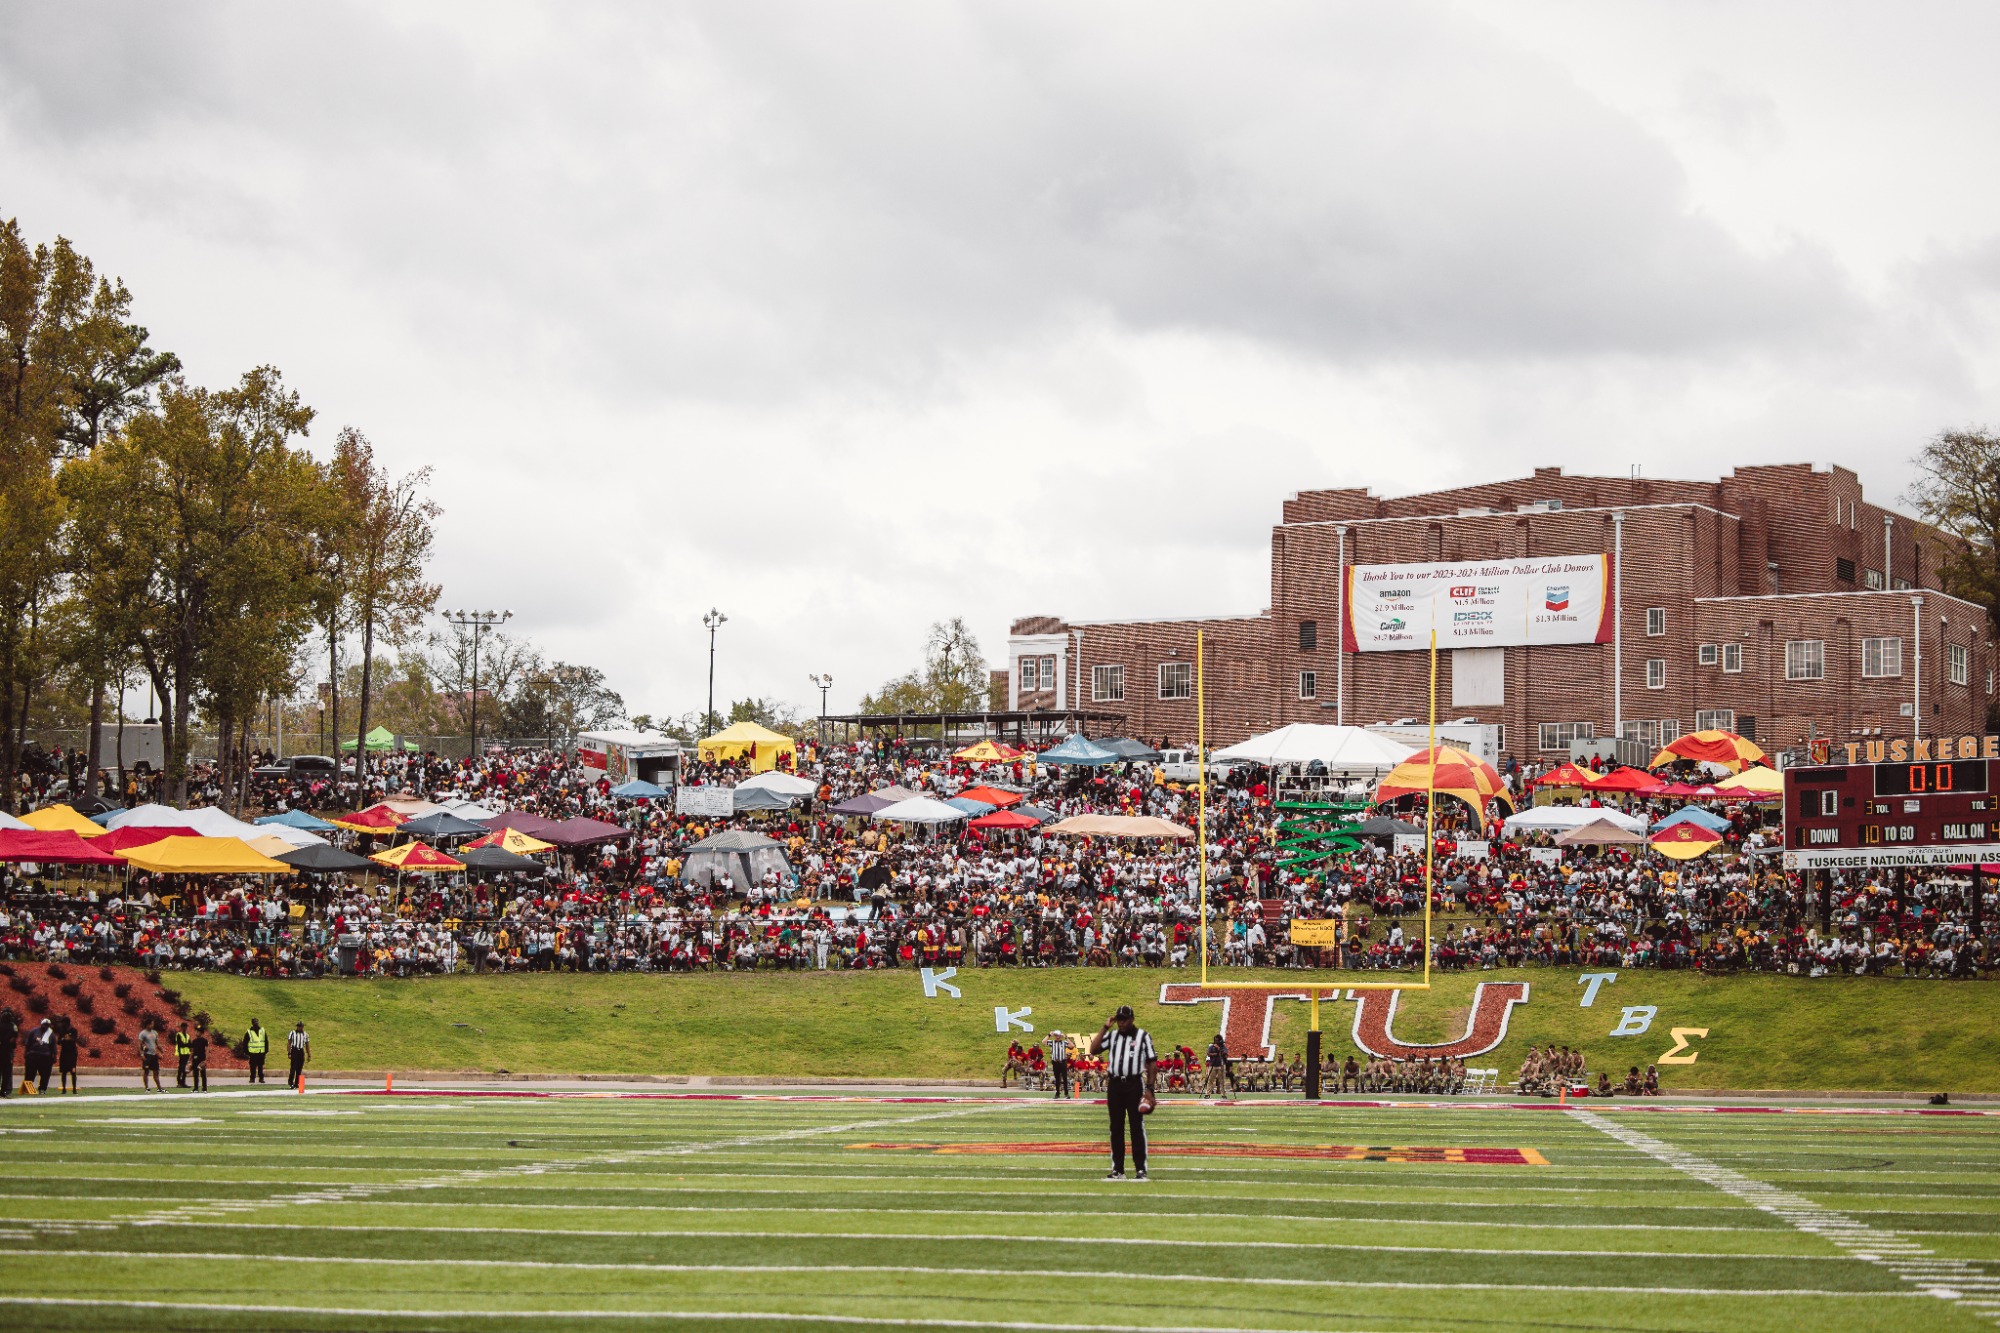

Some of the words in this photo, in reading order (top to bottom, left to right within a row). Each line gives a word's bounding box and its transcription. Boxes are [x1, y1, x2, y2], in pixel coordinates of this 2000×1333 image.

[1363, 571, 1387, 582] Thank
[1390, 572, 1404, 581] You
[1432, 568, 1478, 579] 2023-2024
[1480, 566, 1509, 577] Million
[1513, 564, 1539, 575] Dollar
[1541, 563, 1561, 574] Club
[1563, 563, 1594, 573] Donors
[1380, 589, 1411, 598] amazon
[1453, 587, 1474, 596] CLIF
[1391, 603, 1414, 611] Million
[1454, 611, 1493, 622] IDEXX
[1552, 614, 1577, 622] Million
[1380, 621, 1406, 632] Cargill
[1389, 633, 1413, 641] Million
[1844, 735, 1999, 764] TUSKEGE
[1875, 804, 1890, 814] TOL
[1972, 800, 1986, 810] TOL
[1810, 828, 1839, 844] DOWN
[1865, 825, 1880, 844] 10
[1884, 826, 1897, 841] TO
[1899, 825, 1915, 841] GO
[1943, 824, 1968, 839] BALL
[1970, 823, 1985, 838] ON
[1807, 857, 1867, 868] TUSKEGEE
[1870, 855, 1928, 866] NATIONAL
[1932, 853, 1977, 865] ALUMNI
[920, 966, 962, 998] K
[1576, 971, 1619, 1007] T
[994, 1006, 1034, 1033] K
[1608, 1004, 1658, 1037] B
